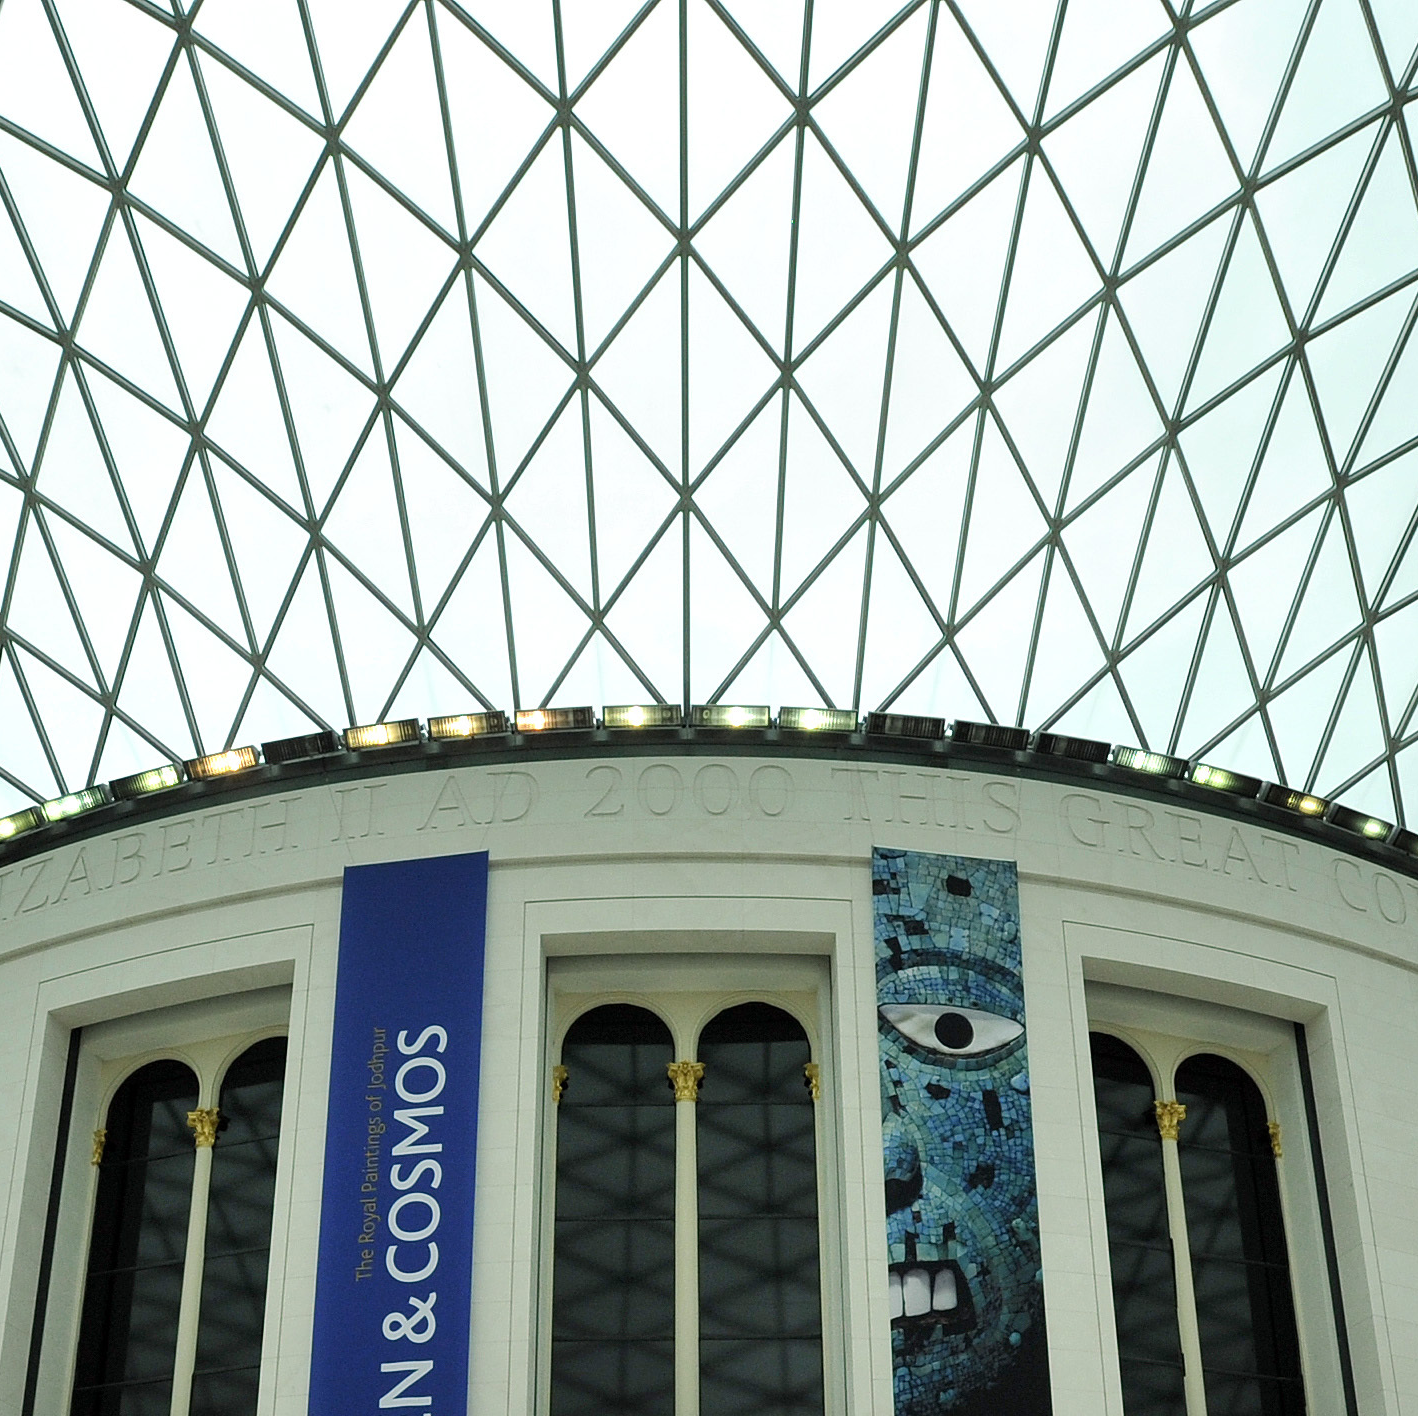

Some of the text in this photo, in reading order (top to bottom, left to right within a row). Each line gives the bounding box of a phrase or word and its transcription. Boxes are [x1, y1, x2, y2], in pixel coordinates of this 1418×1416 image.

[330, 783, 389, 842] II
[416, 771, 540, 833] AD
[583, 763, 793, 819] 2000
[831, 767, 1022, 835] THIS
[1061, 792, 1300, 893] GREAT
[355, 1026, 390, 1282] The Royal Paintings of Jodhpur
[385, 1023, 449, 1284] COSMOS
[382, 1291, 439, 1343] &
